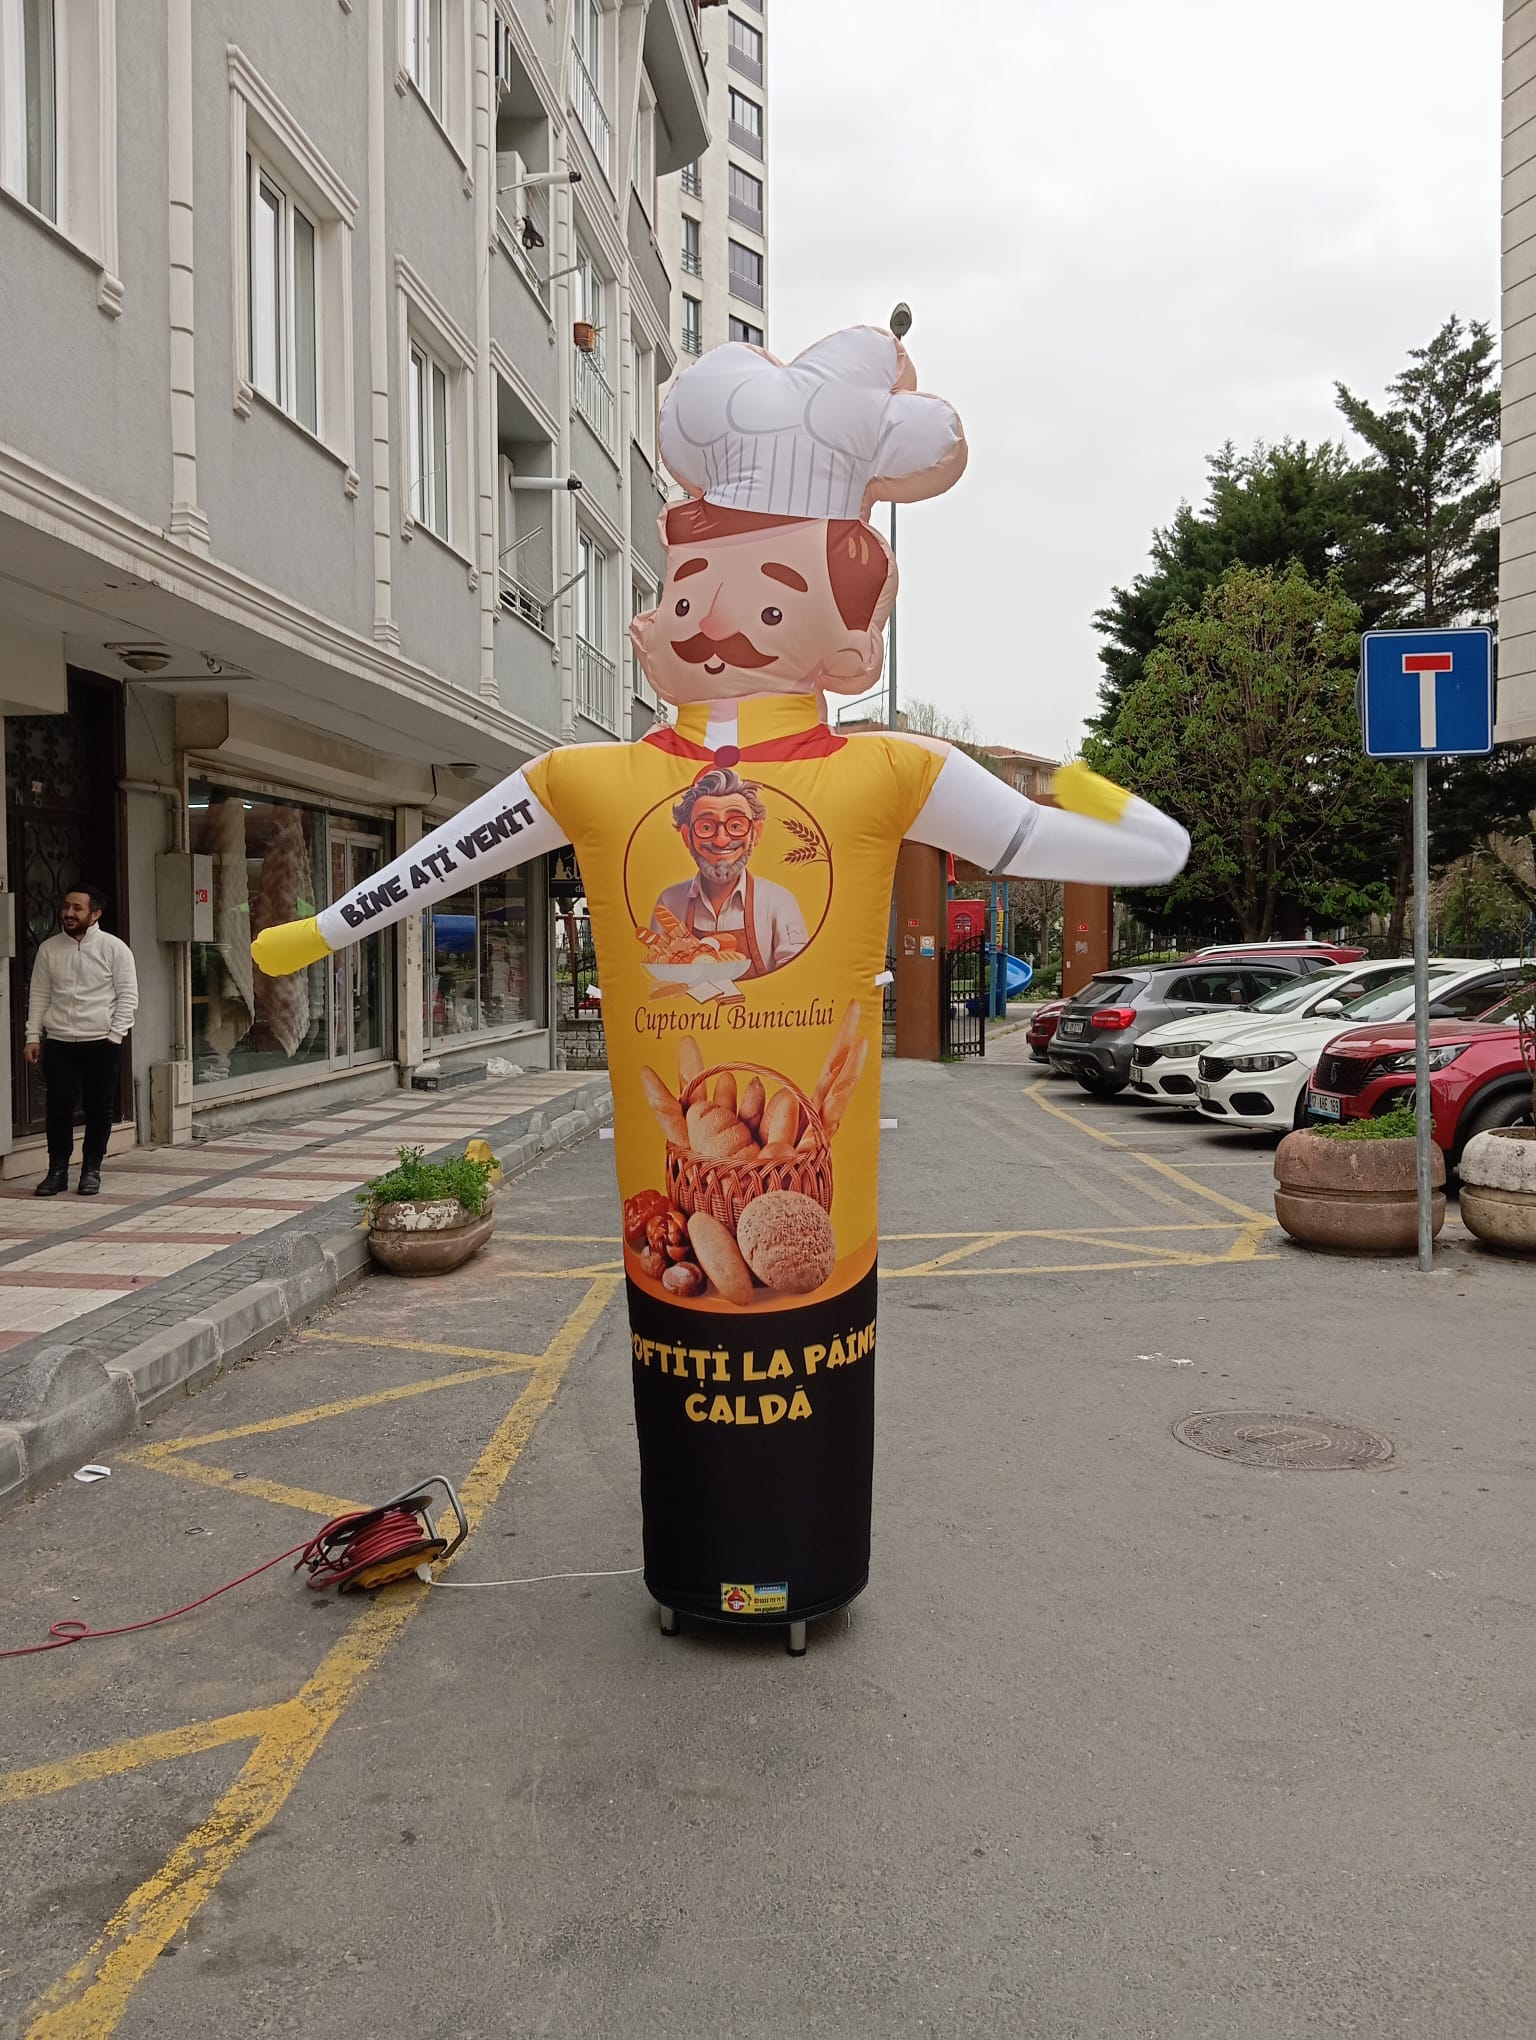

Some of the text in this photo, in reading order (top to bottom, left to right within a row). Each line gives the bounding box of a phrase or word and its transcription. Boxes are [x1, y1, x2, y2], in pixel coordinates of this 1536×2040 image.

[634, 998, 835, 1040] Cuptorul Bunicului
[743, 1348, 794, 1381] LA
